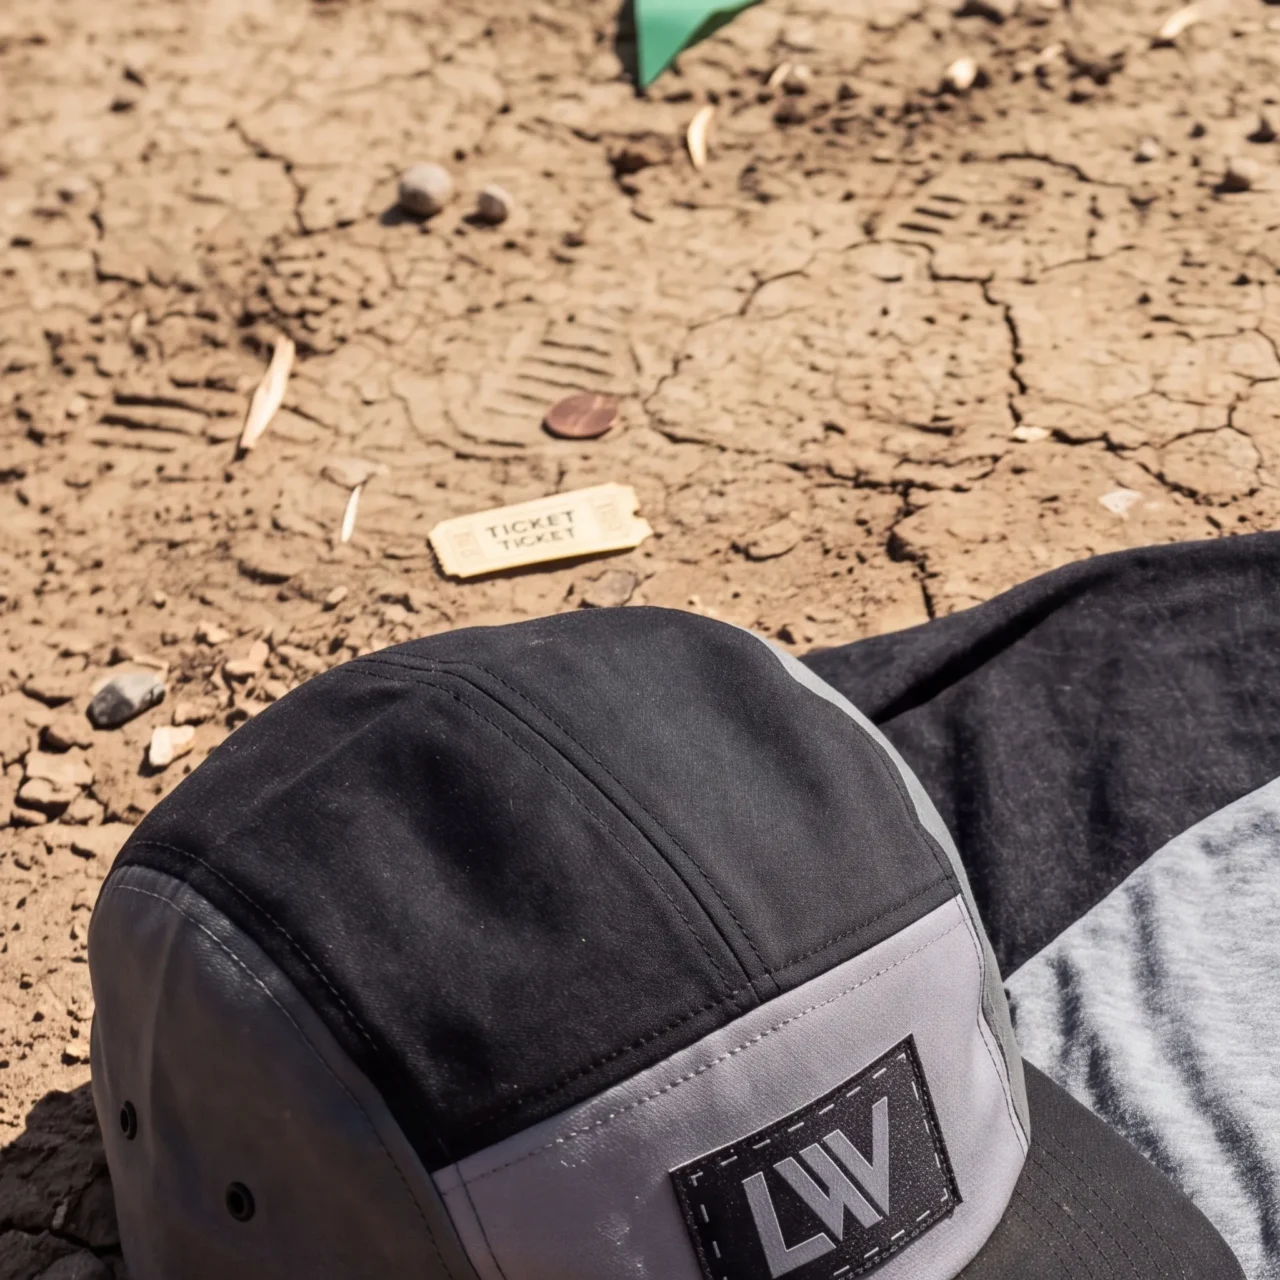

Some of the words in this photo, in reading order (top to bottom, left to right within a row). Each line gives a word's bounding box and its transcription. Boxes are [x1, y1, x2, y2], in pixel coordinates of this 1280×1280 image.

[484, 510, 575, 539] TICKET
[497, 527, 575, 551] TICKET
[741, 1096, 890, 1279] LWV
